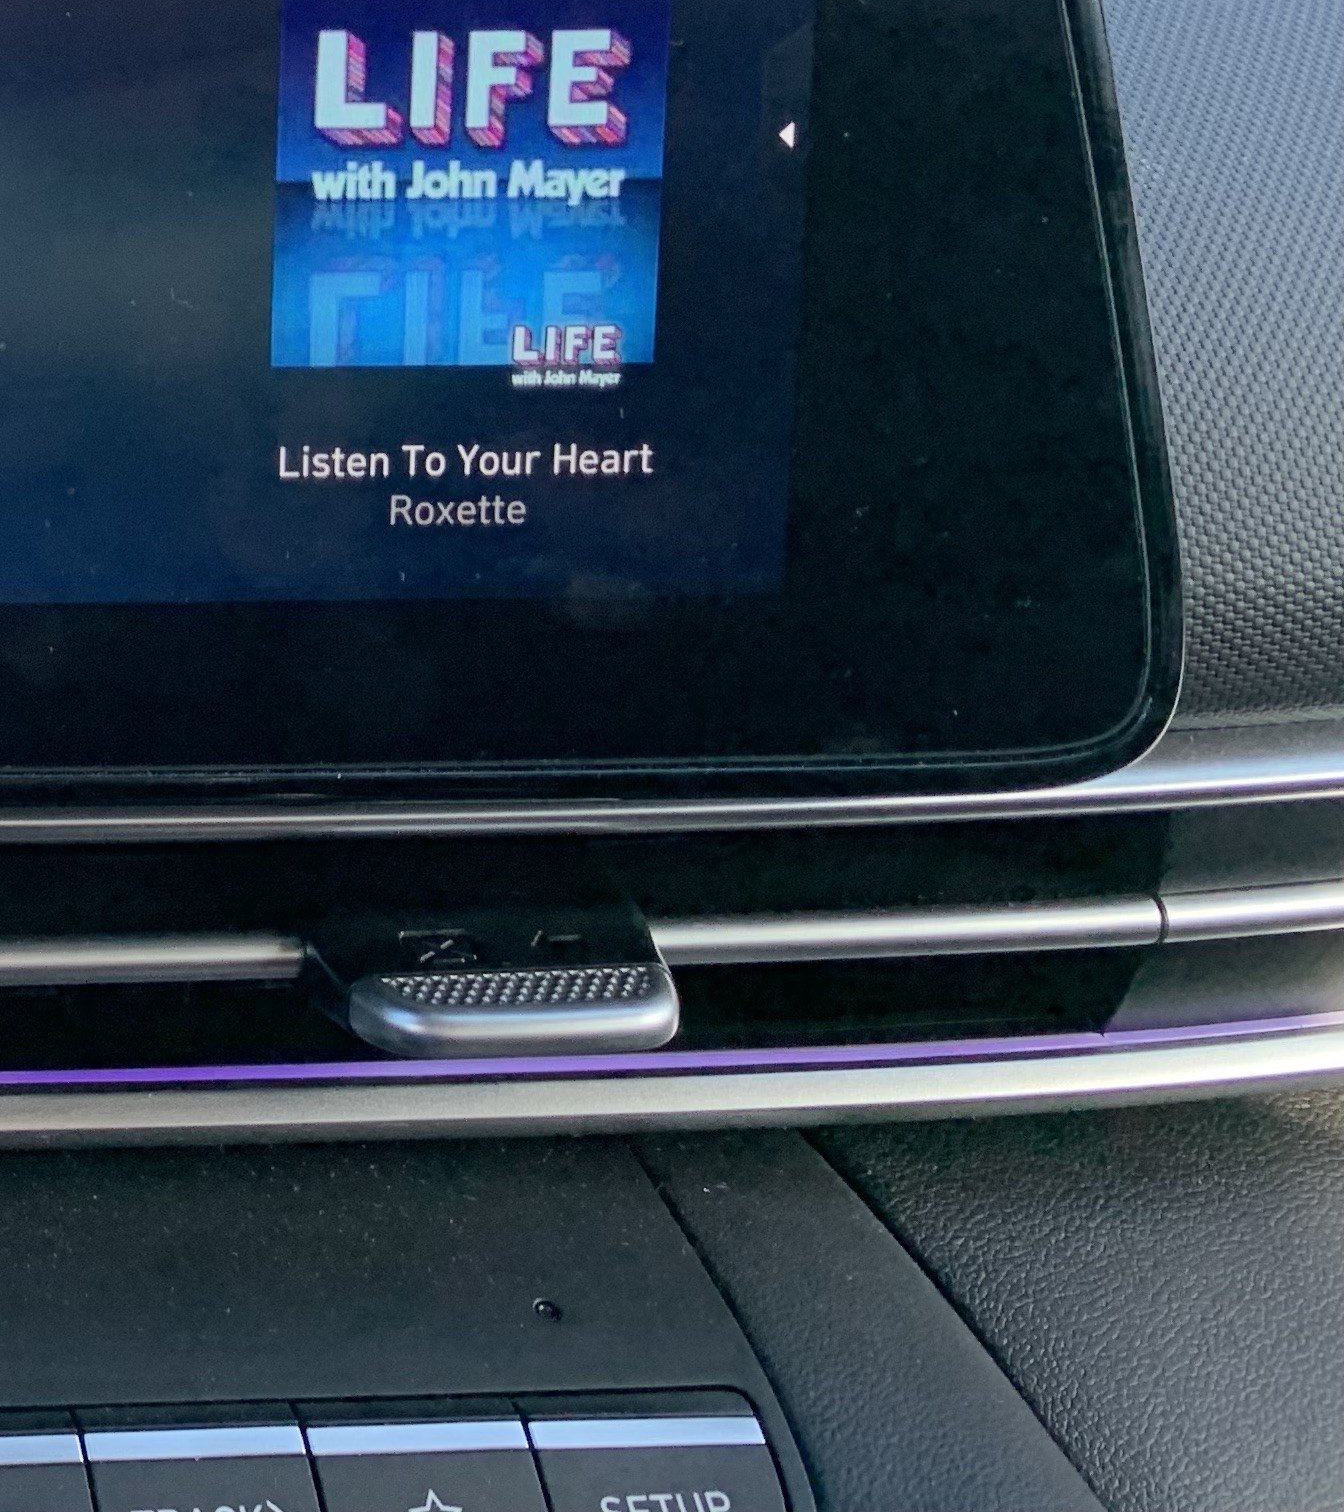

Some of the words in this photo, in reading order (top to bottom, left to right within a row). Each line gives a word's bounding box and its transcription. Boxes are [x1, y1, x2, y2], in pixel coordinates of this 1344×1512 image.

[314, 27, 632, 149] LIFE
[311, 160, 397, 202] with
[405, 160, 498, 201] John
[506, 160, 627, 207] Mayer
[511, 323, 624, 365] LIFE
[510, 367, 542, 387] with
[542, 367, 577, 387] John
[578, 367, 623, 389] Mayer
[278, 445, 390, 480] Listen
[401, 444, 447, 478] To
[457, 443, 542, 477] Your
[553, 442, 654, 476] Heart
[389, 494, 527, 527] Roxette
